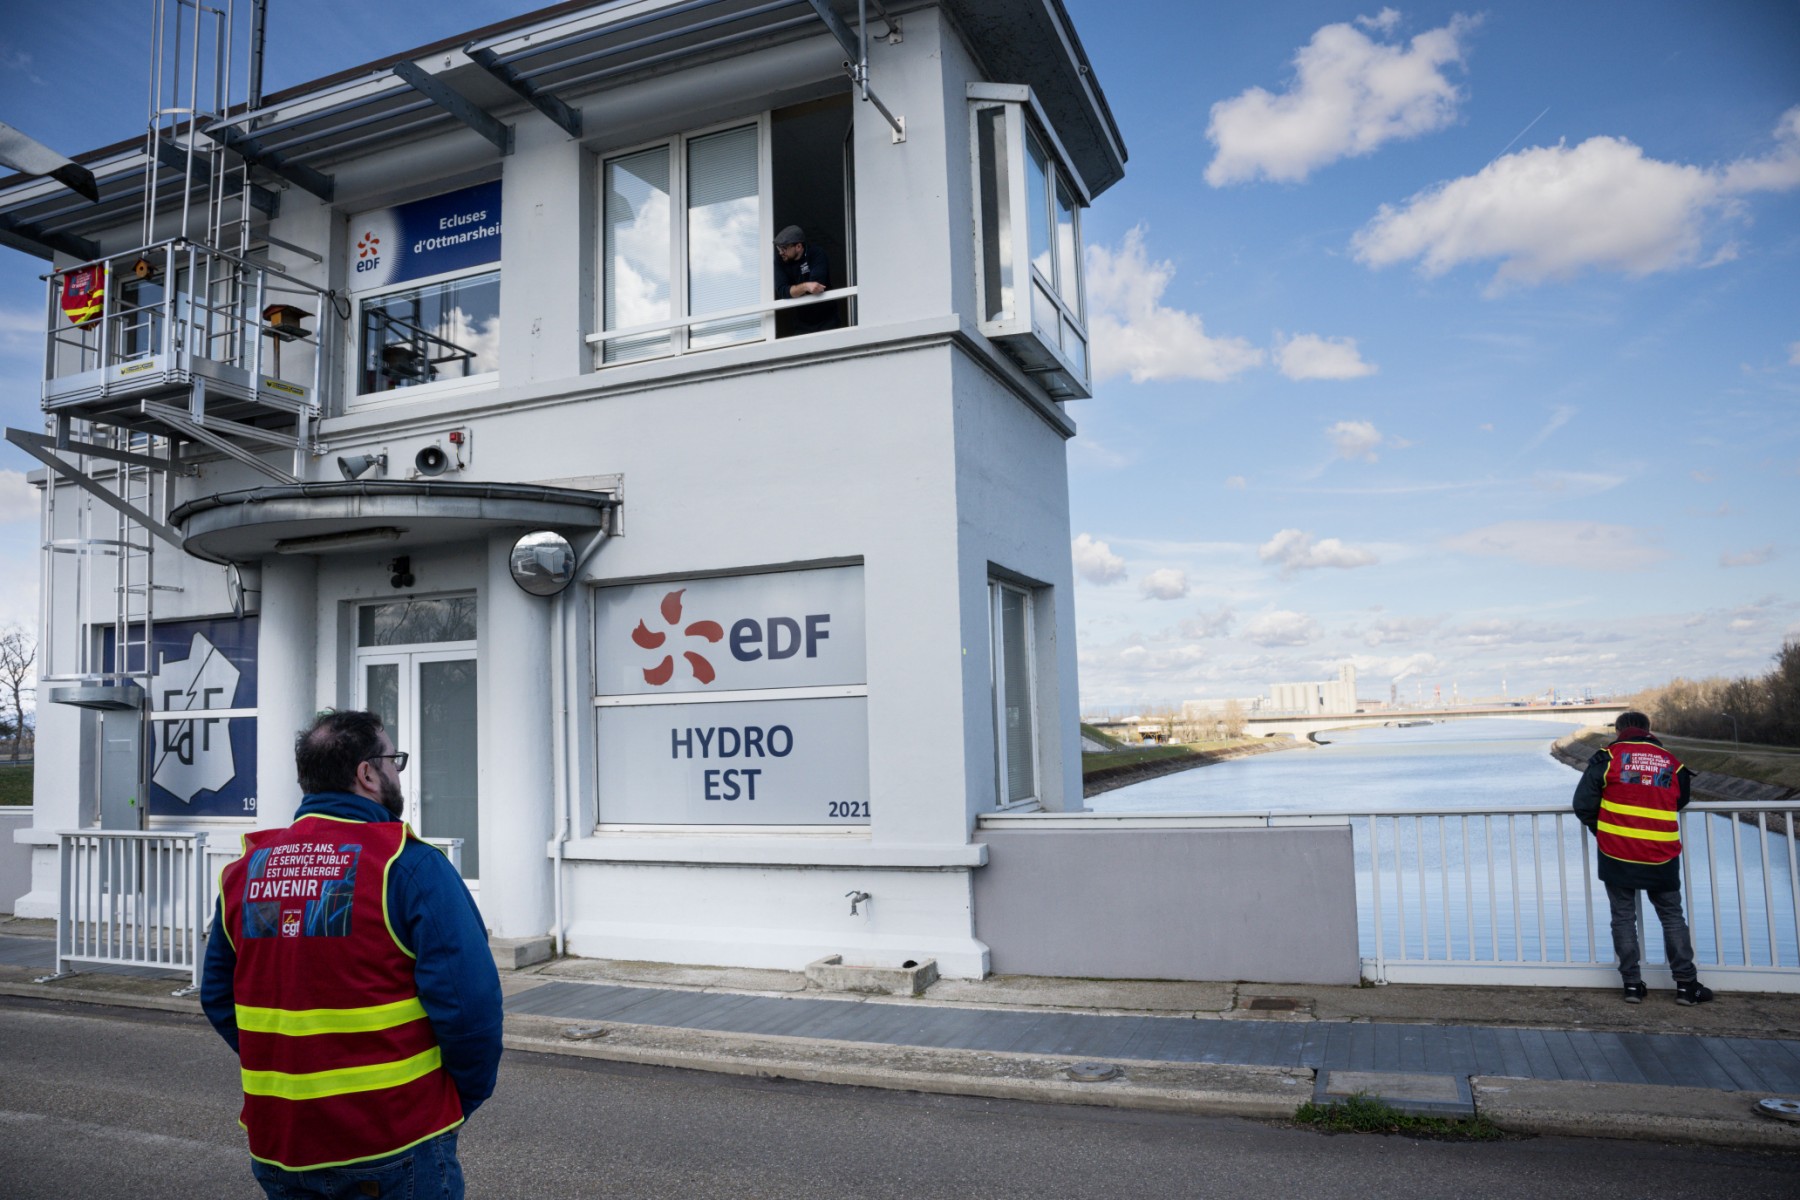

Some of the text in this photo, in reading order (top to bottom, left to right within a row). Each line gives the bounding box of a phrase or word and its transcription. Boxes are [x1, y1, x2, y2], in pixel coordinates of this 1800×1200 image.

[439, 210, 487, 231] Ecluses
[413, 222, 502, 254] d'Ottmarshei
[671, 725, 794, 759] HYDRO
[704, 769, 762, 801] EST
[828, 801, 872, 818] 2021
[272, 843, 336, 856] DEPUIS 75 ANS,
[266, 862, 341, 878] EST UNE ÉNERGIE
[268, 855, 350, 866] LE SERVICE PUBLIC
[249, 879, 318, 899] D'AVENIR
